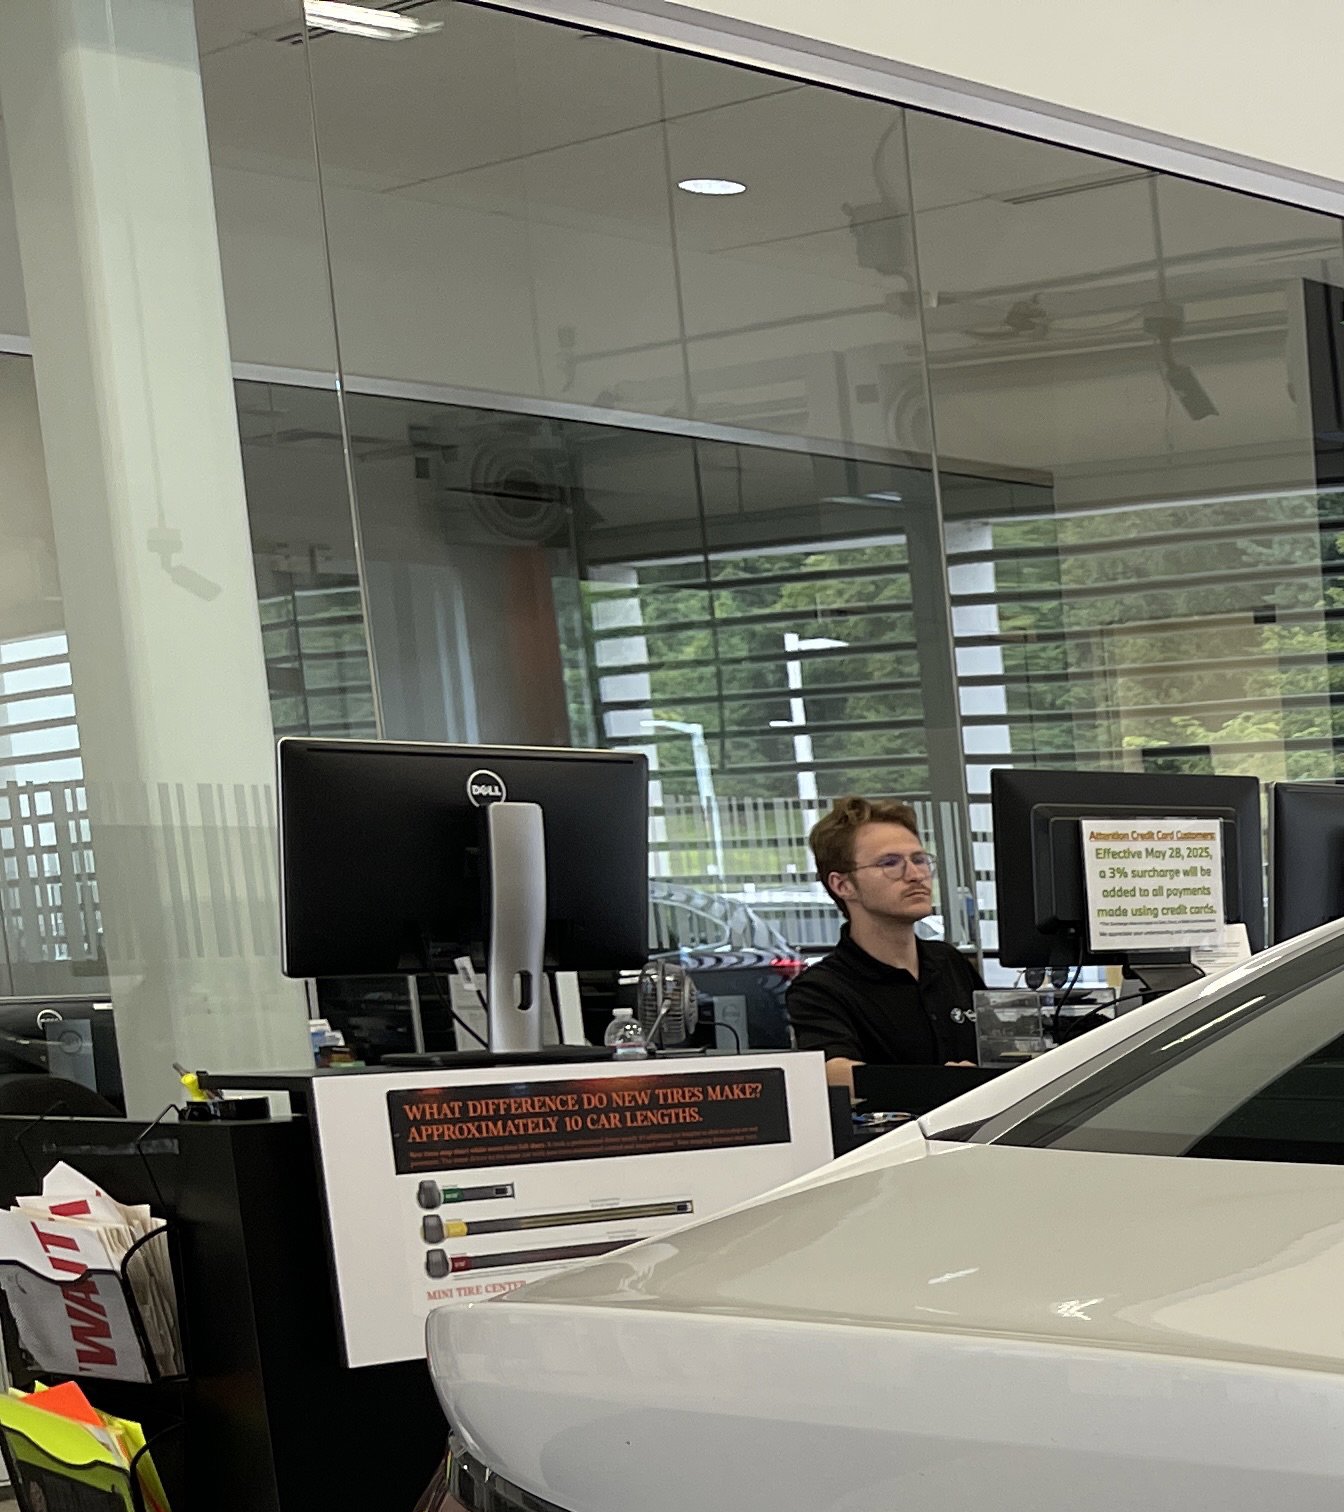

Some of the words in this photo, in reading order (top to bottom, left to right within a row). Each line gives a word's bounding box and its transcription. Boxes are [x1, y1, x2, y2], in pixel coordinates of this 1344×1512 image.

[472, 785, 501, 796] DELL
[1095, 848, 1142, 859] Effective
[1145, 848, 1166, 861] May
[1168, 848, 1184, 860] 28,
[1187, 847, 1212, 860] 2025,
[1099, 870, 1106, 879] a
[1108, 867, 1128, 879] 3%
[1131, 867, 1180, 880] surcharge
[1182, 866, 1198, 877] will
[1200, 866, 1212, 877] be
[1102, 887, 1136, 898] added
[1139, 887, 1150, 897] to
[1152, 886, 1164, 897] all
[1166, 886, 1211, 899] payments
[1097, 906, 1128, 918] made
[1131, 905, 1159, 918] using
[1161, 904, 1187, 915] credit
[1190, 904, 1217, 915] cards.
[403, 1101, 463, 1121] WHAT
[467, 1094, 579, 1117] DIFFERENCE
[582, 1092, 607, 1109] DO
[611, 1089, 651, 1107] NEW
[655, 1086, 702, 1105] TIRES
[706, 1083, 762, 1101] MAKE?
[408, 1116, 558, 1143] APPROXIMATELY
[564, 1115, 582, 1131] 10
[586, 1113, 622, 1129] CAR
[626, 1107, 703, 1127] LENGTHS.
[427, 1288, 454, 1301] MINI
[456, 1285, 483, 1297] TIRE
